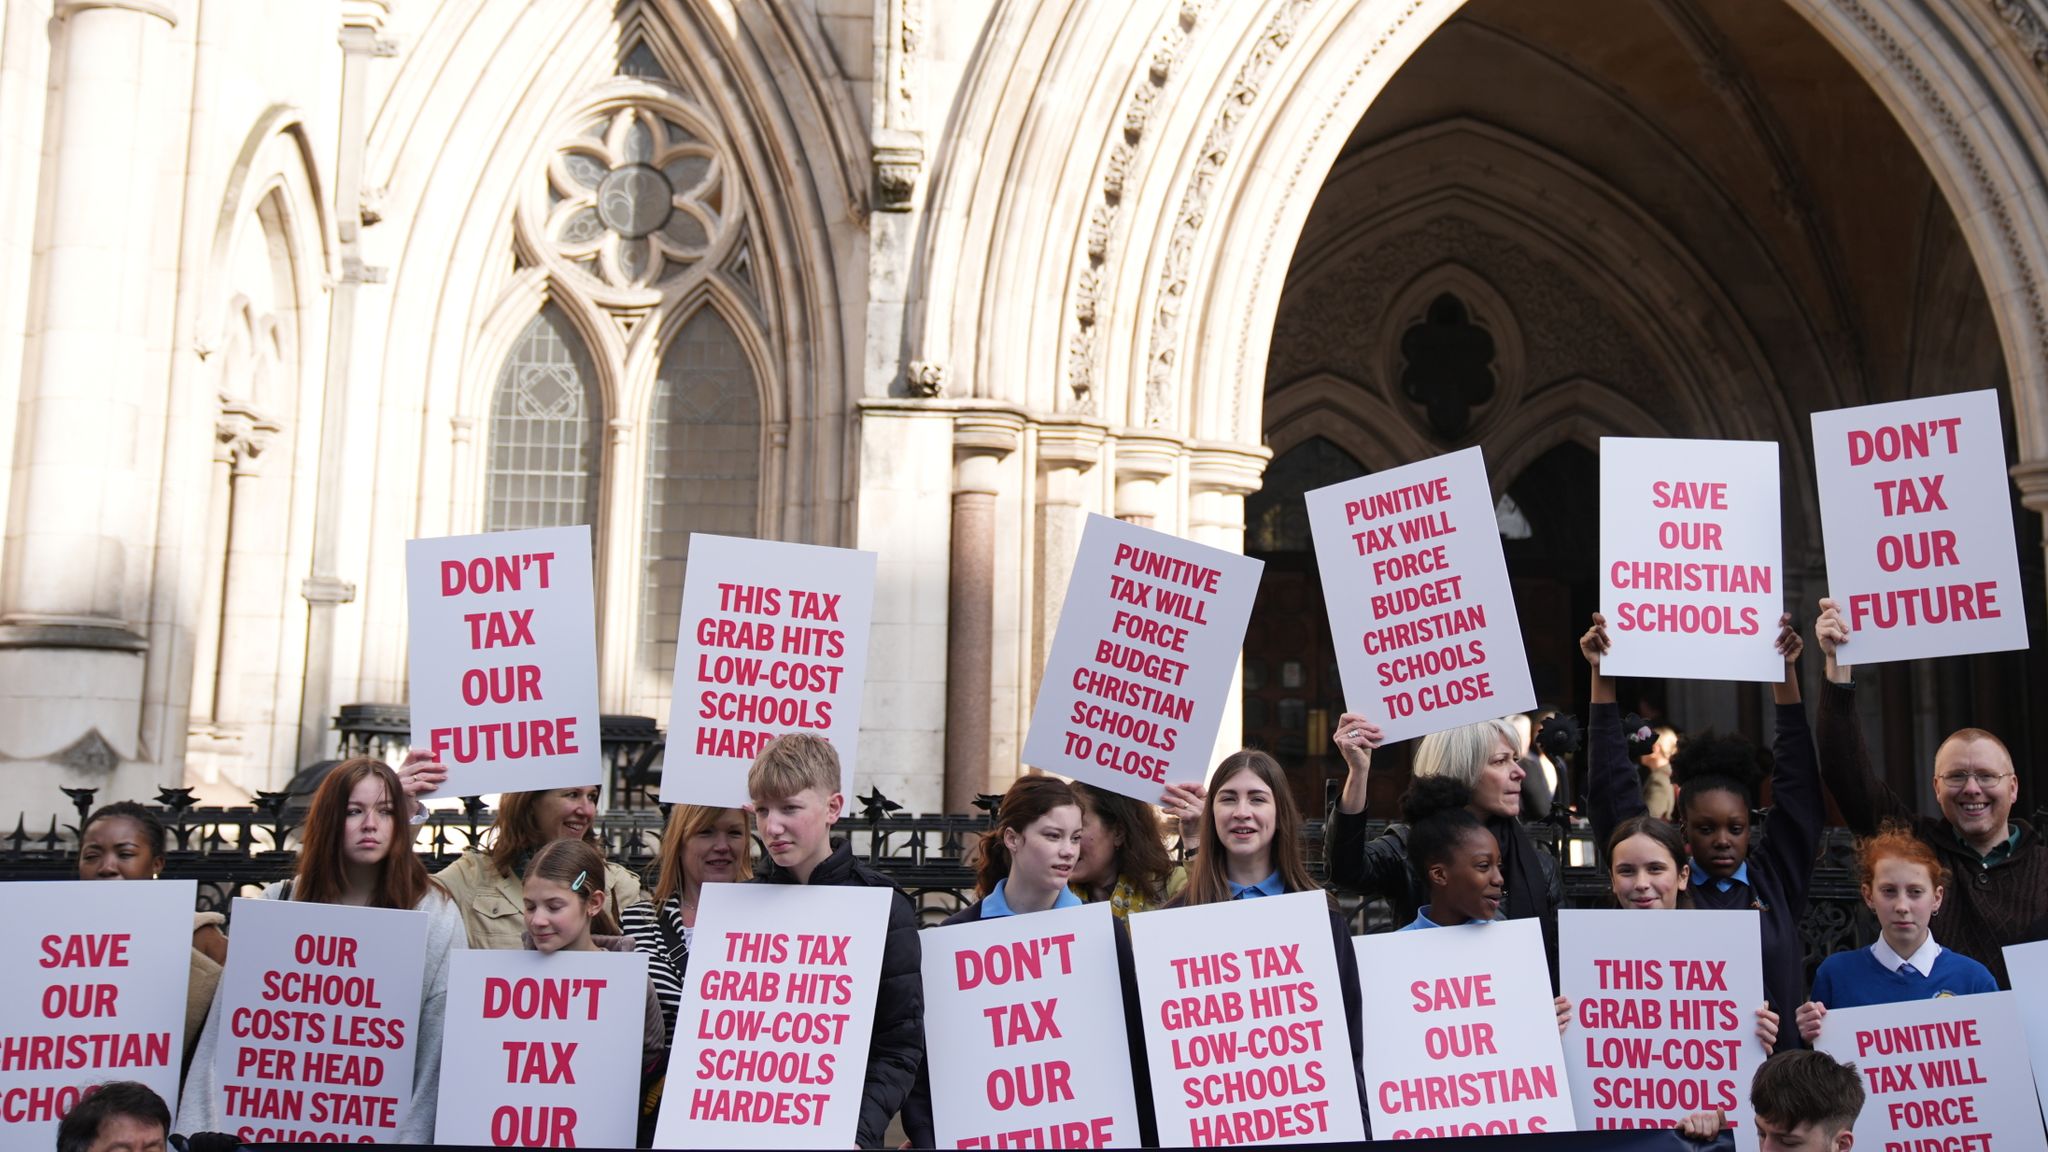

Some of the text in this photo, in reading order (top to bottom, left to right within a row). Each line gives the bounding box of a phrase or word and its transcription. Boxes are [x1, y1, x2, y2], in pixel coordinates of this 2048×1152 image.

[1847, 417, 1962, 467] DON'T
[1345, 477, 1452, 525] PUNITIVE
[1653, 480, 1728, 511] SAVE
[1873, 474, 1948, 518] TAX
[1351, 511, 1457, 556] TAX WILL
[1659, 520, 1723, 551] OUR
[1876, 529, 1961, 573] OUR
[440, 551, 556, 597] DON'T
[1113, 543, 1222, 595] PUNITIVE
[1372, 545, 1450, 586] FORCE
[1611, 560, 1772, 594] CHRISTIAN
[718, 582, 841, 623] THIS TAX
[1110, 575, 1207, 625] TAX WILL
[1371, 575, 1462, 620] BUDGET
[1617, 602, 1760, 636] SCHOOLS
[1849, 581, 2001, 632] FUTURE
[463, 608, 536, 650] TAX
[696, 617, 846, 659] GRAB HITS
[1112, 610, 1189, 653] FORCE
[1362, 604, 1488, 656] CHRISTIAN
[697, 653, 845, 695] LOW-COST
[1094, 639, 1190, 686] BUDGET
[1376, 639, 1487, 687] SCHOOLS
[461, 664, 543, 707] OUR
[1071, 667, 1195, 723] CHRISTIAN
[1382, 672, 1494, 719] TO CLOSE
[699, 689, 833, 730] SCHOOLS
[1072, 701, 1177, 751] SCHOOLS
[430, 717, 579, 764] FUTURE
[1065, 731, 1169, 785] TO CLOSE
[38, 933, 132, 969] SAVE
[295, 933, 358, 969] OUR
[725, 931, 852, 967] THIS TAX
[954, 932, 1077, 991] DON'T
[1170, 943, 1304, 990] THIS TAX
[262, 970, 382, 1009] SCHOOL
[699, 969, 853, 1006] GRAB HITS
[1410, 973, 1497, 1013] SAVE
[1593, 959, 1727, 992] THIS TAX
[42, 983, 119, 1019] OUR
[482, 977, 608, 1021] DON'T
[1160, 981, 1319, 1031] GRAB HITS
[1578, 997, 1740, 1032] GRAB HITS
[231, 1007, 405, 1050] COSTS LESS
[697, 1008, 851, 1046] LOW-COST
[983, 997, 1063, 1048] TAX
[1424, 1023, 1498, 1061] OUR
[1856, 1019, 1982, 1057] PUNITIVE
[0, 1032, 171, 1071] HRISTIAN
[237, 1046, 385, 1087] PER HEAD
[502, 1041, 578, 1085] TAX
[695, 1047, 836, 1086] SCHOOLS
[1171, 1019, 1324, 1071] LOW-COST
[1586, 1037, 1743, 1071] LOW-COST
[986, 1060, 1075, 1112] OUR
[1183, 1060, 1327, 1110] SCHOOLS
[1378, 1064, 1559, 1115] CHRISTIAN
[1593, 1076, 1738, 1112] SCHOOLS
[1863, 1057, 1987, 1094] TAX WILL
[223, 1085, 399, 1129] THAN STATE
[491, 1105, 578, 1149] OUR
[689, 1088, 832, 1127] HARDEST
[1189, 1099, 1329, 1149] HARDEST
[1888, 1095, 1979, 1131] FORCE
